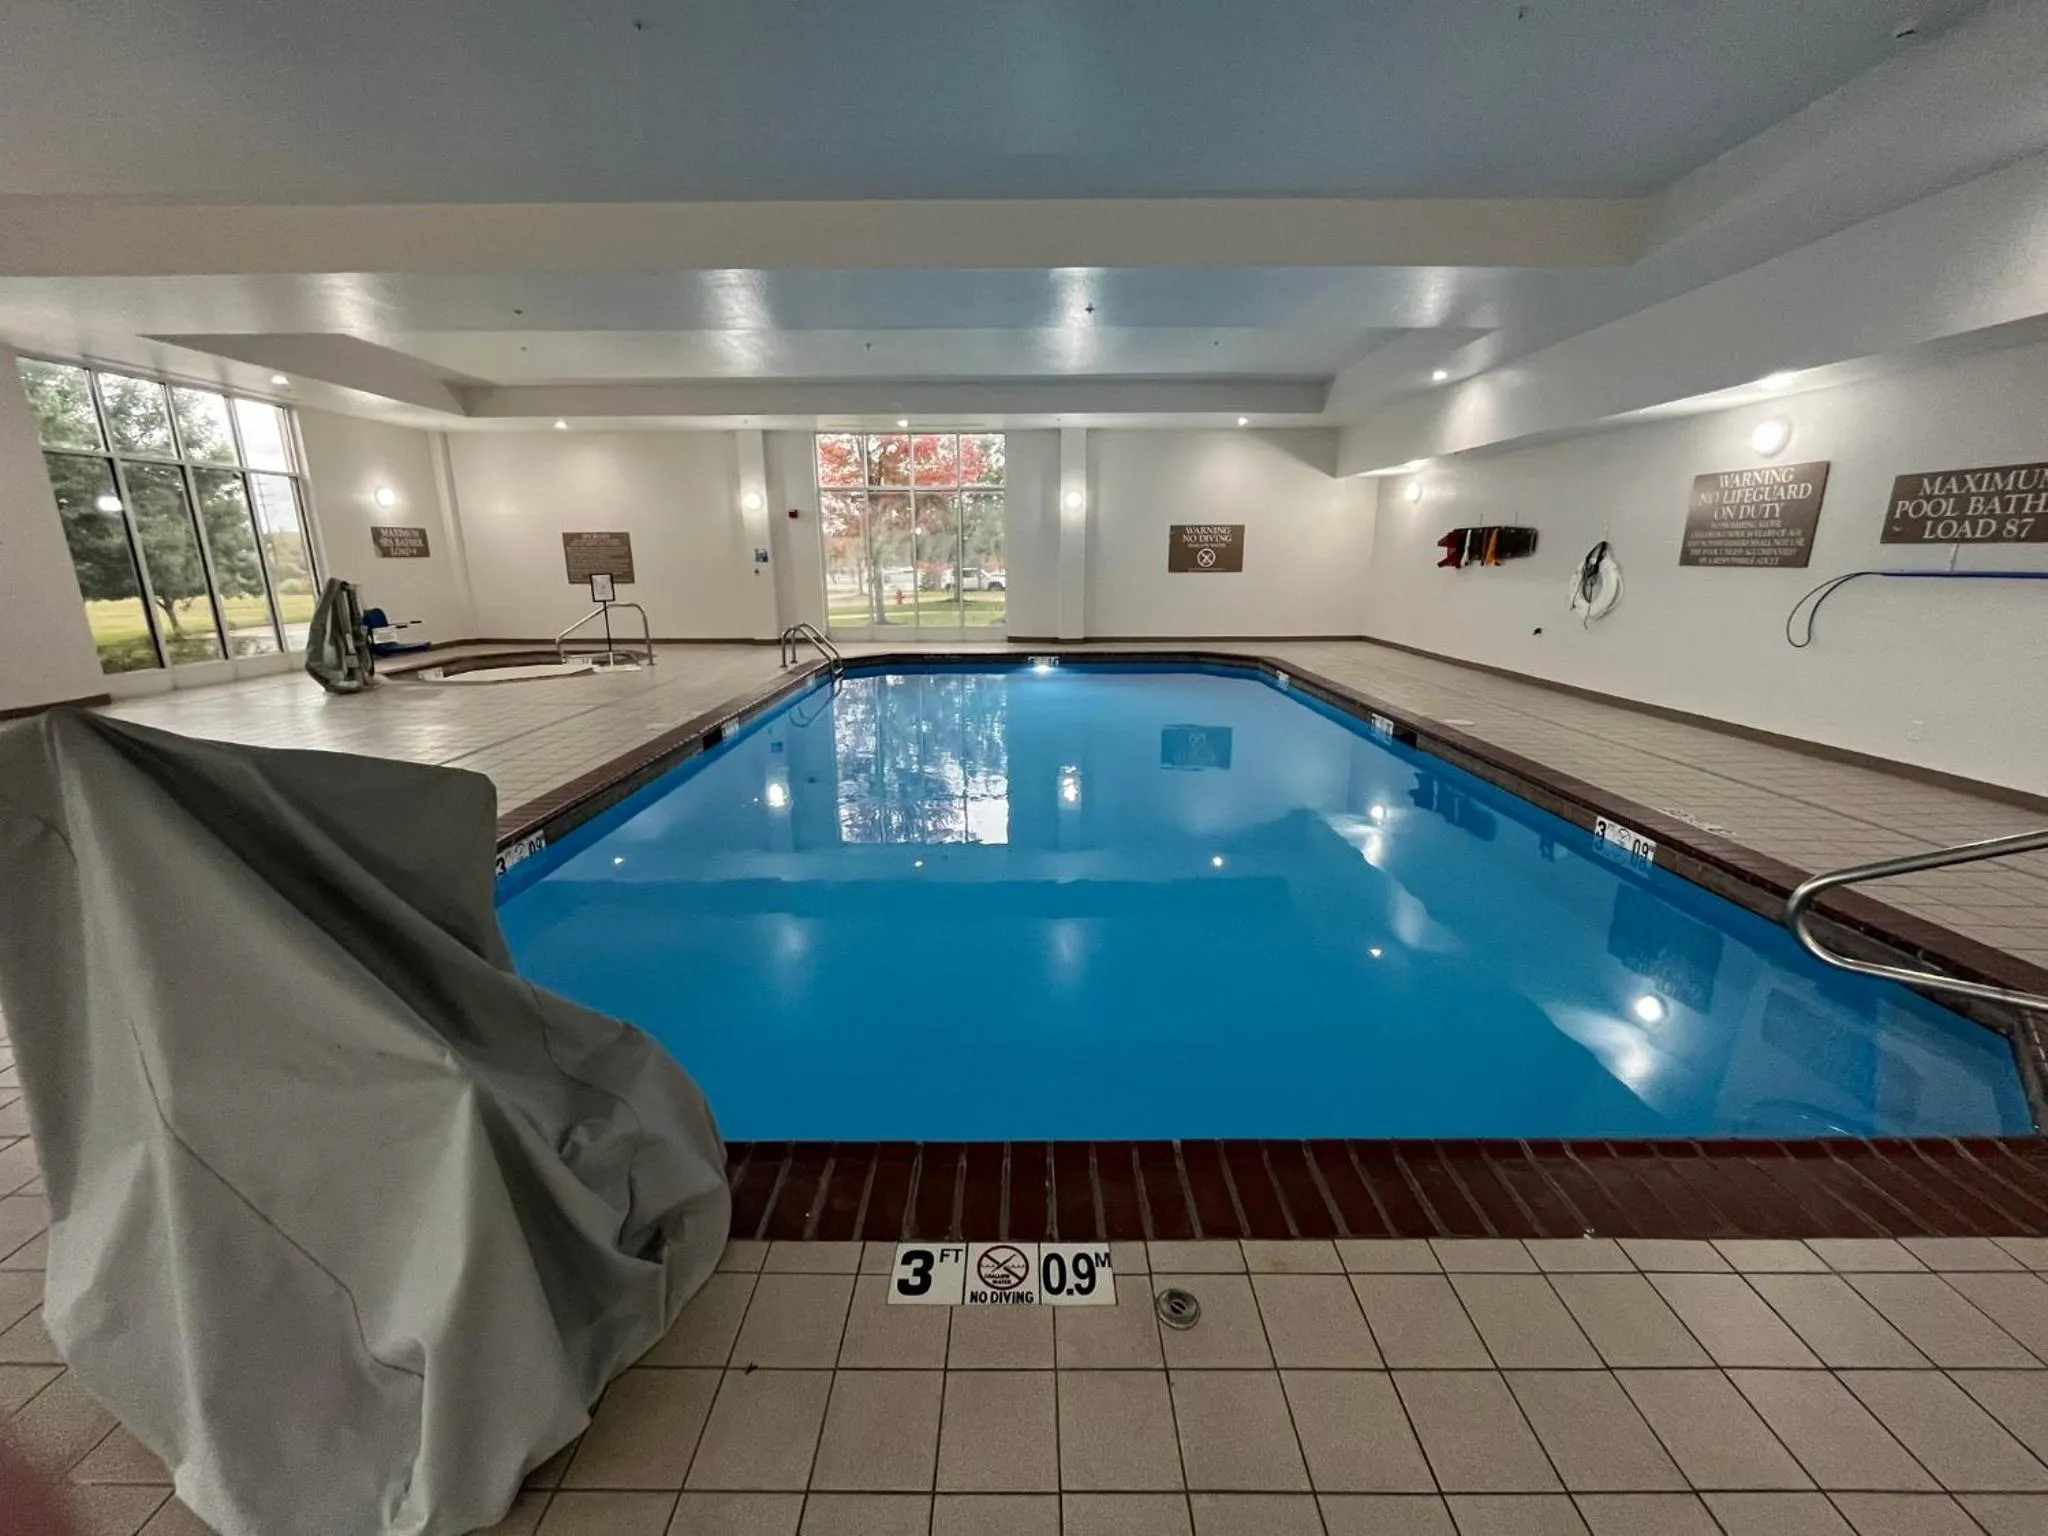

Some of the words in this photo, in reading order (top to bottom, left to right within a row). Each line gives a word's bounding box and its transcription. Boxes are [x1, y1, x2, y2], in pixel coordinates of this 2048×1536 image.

[1719, 467, 1795, 489] WARNING
[1698, 492, 1719, 506] NO
[1723, 482, 1813, 505] LIFEGUARD
[1713, 505, 1737, 521] ON
[1738, 502, 1785, 521] DUTY
[1894, 497, 1960, 519] POOL
[1183, 534, 1197, 542] NO
[1199, 534, 1232, 542] DIVING
[1186, 526, 1231, 534] WARNING
[1923, 518, 1997, 539] LOAD
[2002, 517, 2035, 539] 87
[897, 1249, 935, 1296] 3
[939, 1248, 964, 1263] FT
[1042, 1252, 1097, 1296] 0.9
[1094, 1252, 1111, 1268] M
[970, 1291, 988, 1304] NO
[990, 1291, 1034, 1304] DIVING
